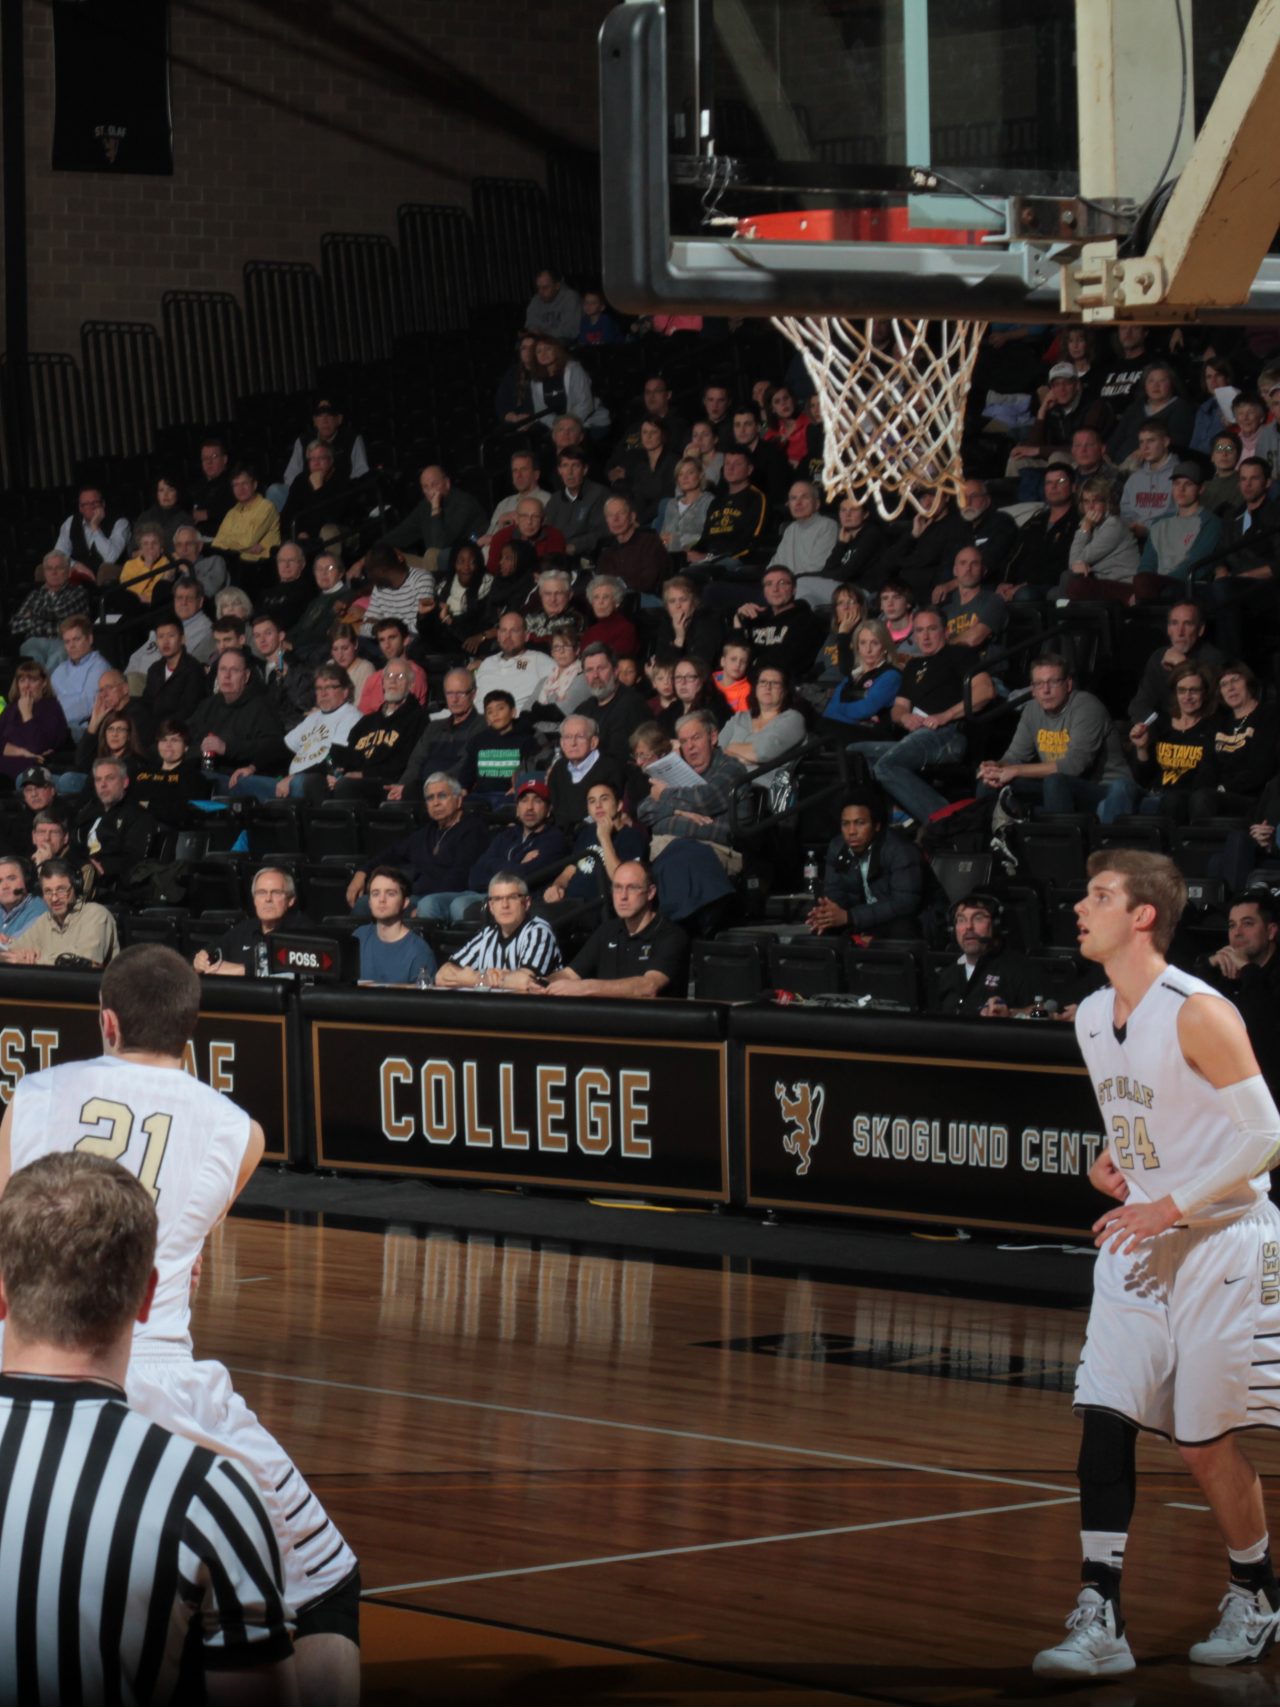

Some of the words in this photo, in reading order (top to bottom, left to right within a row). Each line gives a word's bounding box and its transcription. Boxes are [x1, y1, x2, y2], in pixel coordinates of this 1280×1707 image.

[289, 951, 319, 967] POSS.
[380, 1056, 652, 1160] COLLEGE
[1116, 1076, 1154, 1110] OLAF
[73, 1097, 173, 1207] 21
[852, 1113, 1009, 1170] SKOGLUND
[1021, 1127, 1108, 1176] CENT
[1111, 1115, 1160, 1171] 24
[1260, 1241, 1280, 1306] OLES
